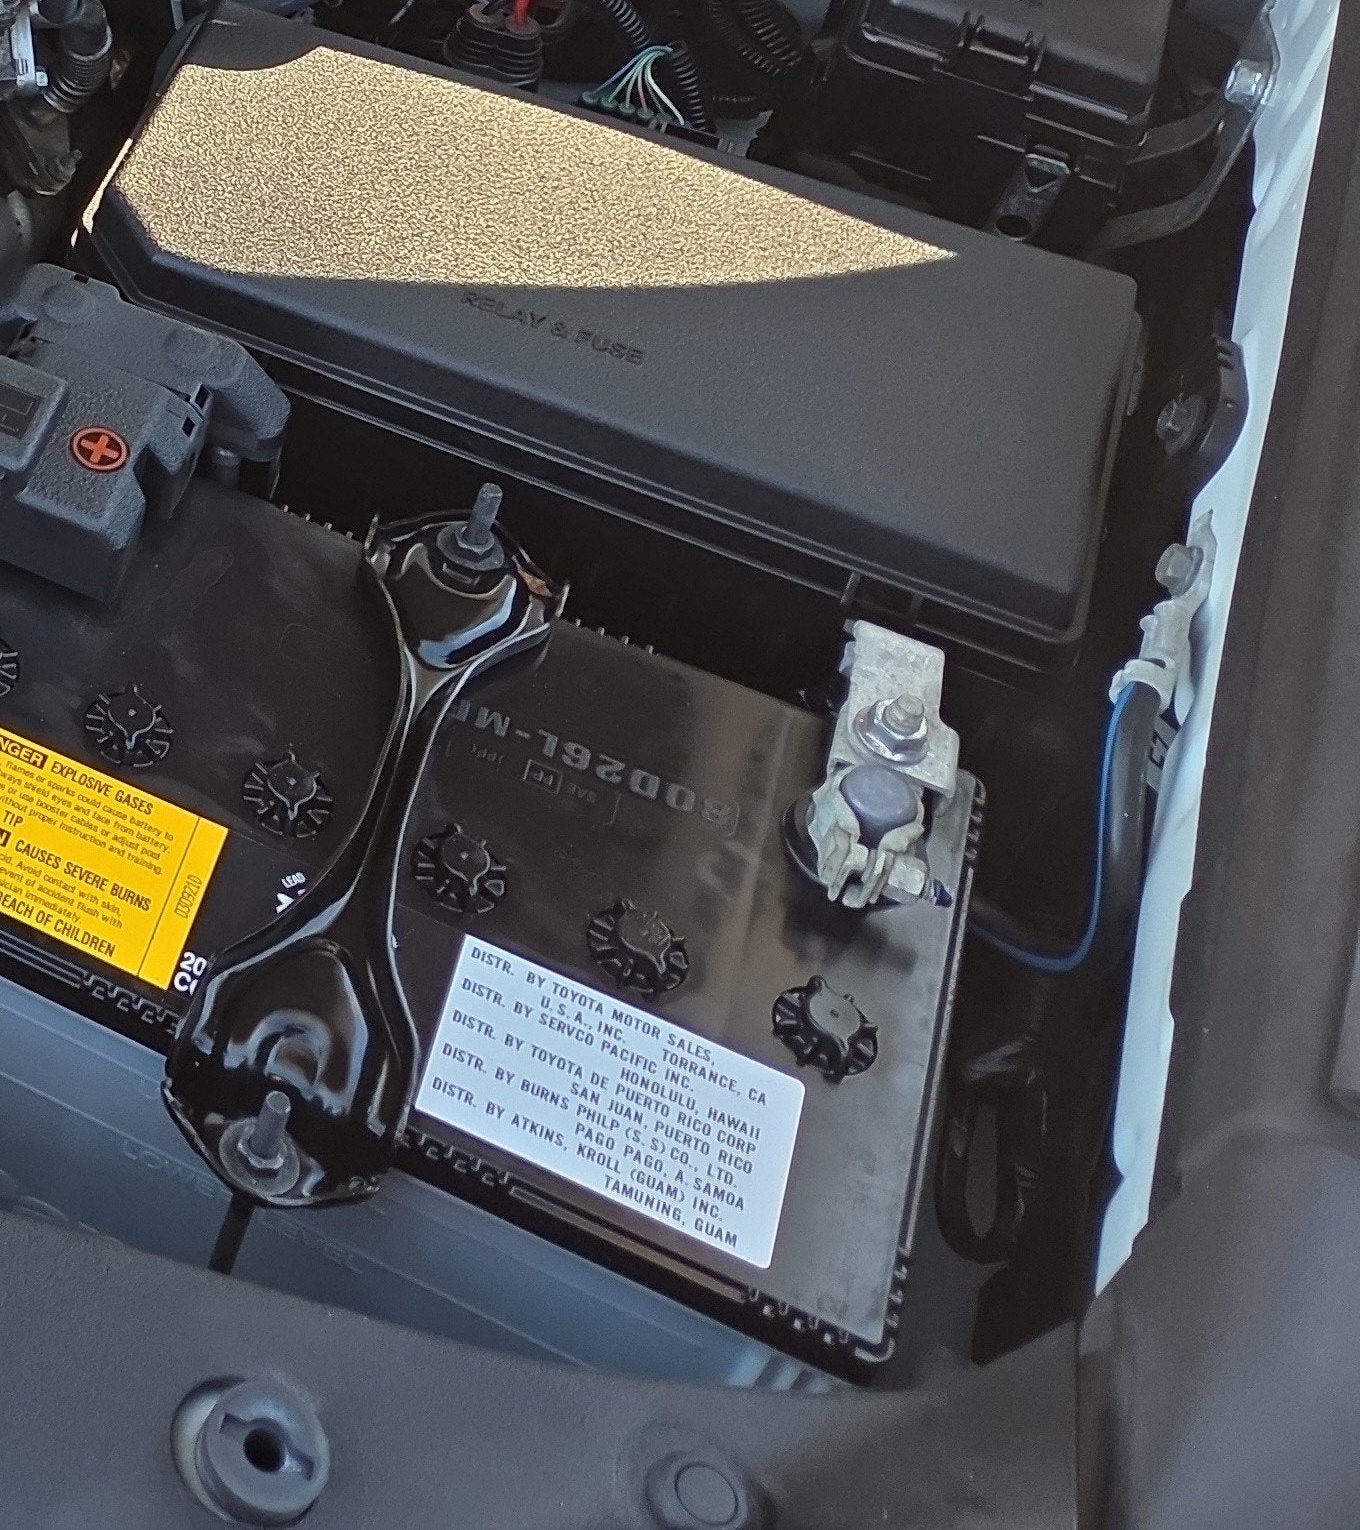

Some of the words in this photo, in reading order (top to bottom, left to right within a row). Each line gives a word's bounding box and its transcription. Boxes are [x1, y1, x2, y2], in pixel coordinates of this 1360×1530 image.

[459, 288, 547, 330] RELAY
[572, 327, 648, 367] FUSE
[3, 810, 24, 827] TIP
[6, 761, 35, 779] flames
[35, 775, 46, 783] or
[47, 780, 76, 797] sparks
[77, 794, 102, 809] could
[102, 805, 128, 821] cause
[129, 816, 163, 837] battery
[164, 831, 174, 841] to
[7, 787, 18, 795] or
[19, 792, 34, 803] use
[36, 798, 69, 818] booster
[70, 815, 99, 832] cables
[100, 829, 111, 837] or
[111, 834, 140, 851] adjust
[140, 847, 161, 861] post
[23, 782, 50, 798] shield
[51, 794, 72, 808] eyes
[73, 804, 91, 816] and
[92, 811, 111, 826] face
[113, 821, 135, 836] from
[50, 761, 113, 797] EXPLOSIVE
[115, 790, 153, 815] GASES
[28, 809, 58, 826] proper
[59, 821, 107, 849] instruction
[108, 845, 126, 858] and
[0, 866, 24, 883] event
[25, 878, 36, 888] of
[37, 884, 75, 906] accident
[76, 901, 99, 918] flush
[101, 915, 122, 929] with
[15, 839, 61, 869] CAUSES
[63, 862, 109, 891] SEVERE
[110, 883, 151, 911] BURNS
[15, 861, 42, 878] Avoid
[43, 874, 76, 894] contact
[78, 890, 99, 905] with
[280, 871, 306, 888] LEAD
[35, 910, 53, 926] OF
[54, 919, 116, 957] CHILDREN
[462, 978, 505, 1008] DISTR.
[513, 1001, 533, 1018] BY
[538, 1012, 594, 1046] SERVCO
[601, 1039, 657, 1074] PACIFIC
[664, 1068, 694, 1092] INC.
[471, 947, 514, 976] DISTR.
[526, 971, 546, 988] BY
[553, 982, 603, 1015] TOYOTA
[611, 1009, 661, 1040] MOTOR
[667, 1033, 715, 1066] SALES,
[452, 1009, 496, 1040] DISTR.
[504, 1033, 524, 1051] BY
[531, 1044, 582, 1079] TOYOTA
[590, 1072, 609, 1090] DE
[615, 1083, 670, 1118] PUERTO
[677, 1111, 711, 1136] RICO
[717, 1129, 756, 1154] CORP
[620, 1067, 699, 1115] HONOLULU,
[707, 1107, 760, 1140] HAWAII
[662, 1048, 741, 1096] TORRANCE,
[748, 1088, 766, 1106] CA
[432, 1077, 477, 1108] DISTR.
[485, 1101, 505, 1119] BY
[511, 1113, 567, 1151] ATKINS,
[577, 1143, 621, 1174] KROLL
[630, 1169, 685, 1202] (GUAM)
[692, 1196, 722, 1221] INC.
[442, 1043, 487, 1073] DISTR.
[495, 1067, 515, 1085] BY
[520, 1079, 569, 1110] BURNS
[576, 1103, 620, 1131] PHILP
[707, 1163, 737, 1188] LTD.
[570, 1082, 600, 1105] SAN
[608, 1099, 648, 1130] JUAN,
[654, 1120, 710, 1155] PUERTO
[718, 1149, 753, 1174] RICO
[575, 1122, 615, 1150] PAGO
[623, 1144, 667, 1178] PAGO,
[258, 1215, 366, 1274] LEVEL
[605, 1174, 685, 1226] TAMUNING,
[694, 1217, 738, 1248] GUAM
